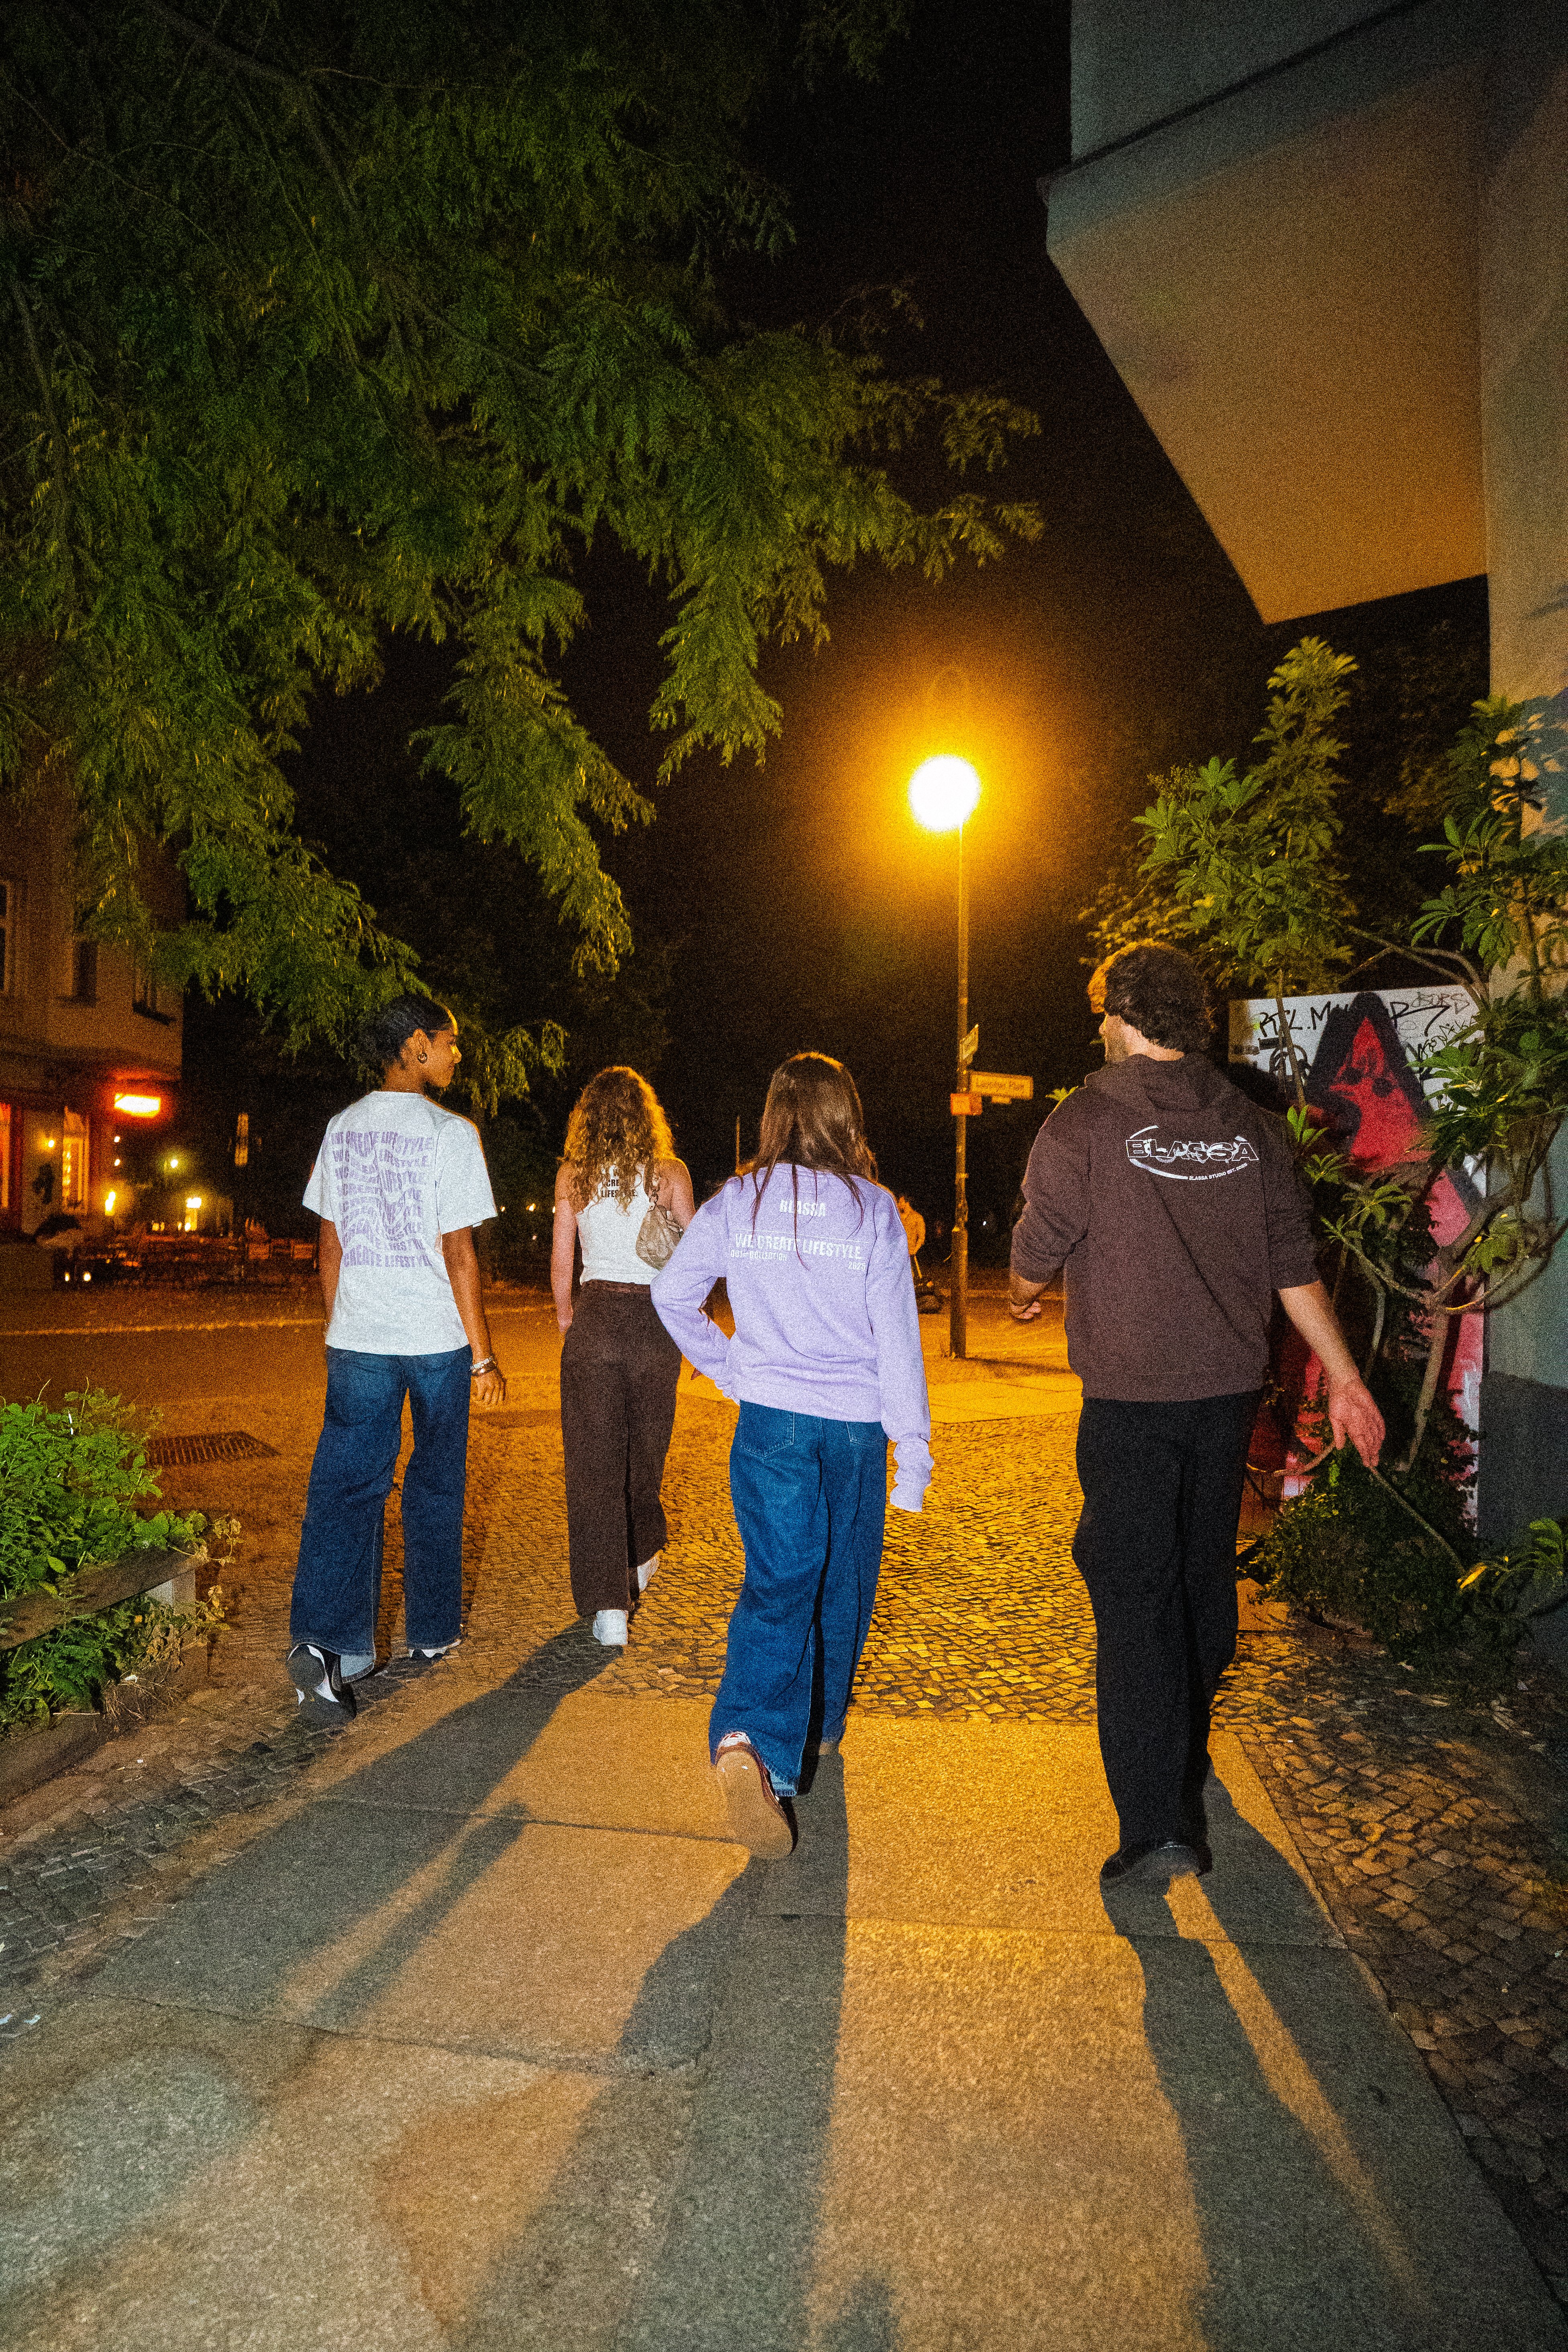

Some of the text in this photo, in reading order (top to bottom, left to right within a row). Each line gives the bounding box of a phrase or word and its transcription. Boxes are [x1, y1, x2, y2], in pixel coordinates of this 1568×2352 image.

[1125, 1138, 1259, 1161] BLASSA
[779, 1199, 826, 1217] BLASSA
[757, 1235, 800, 1252] CREATE
[847, 1261, 866, 1271] 2025
